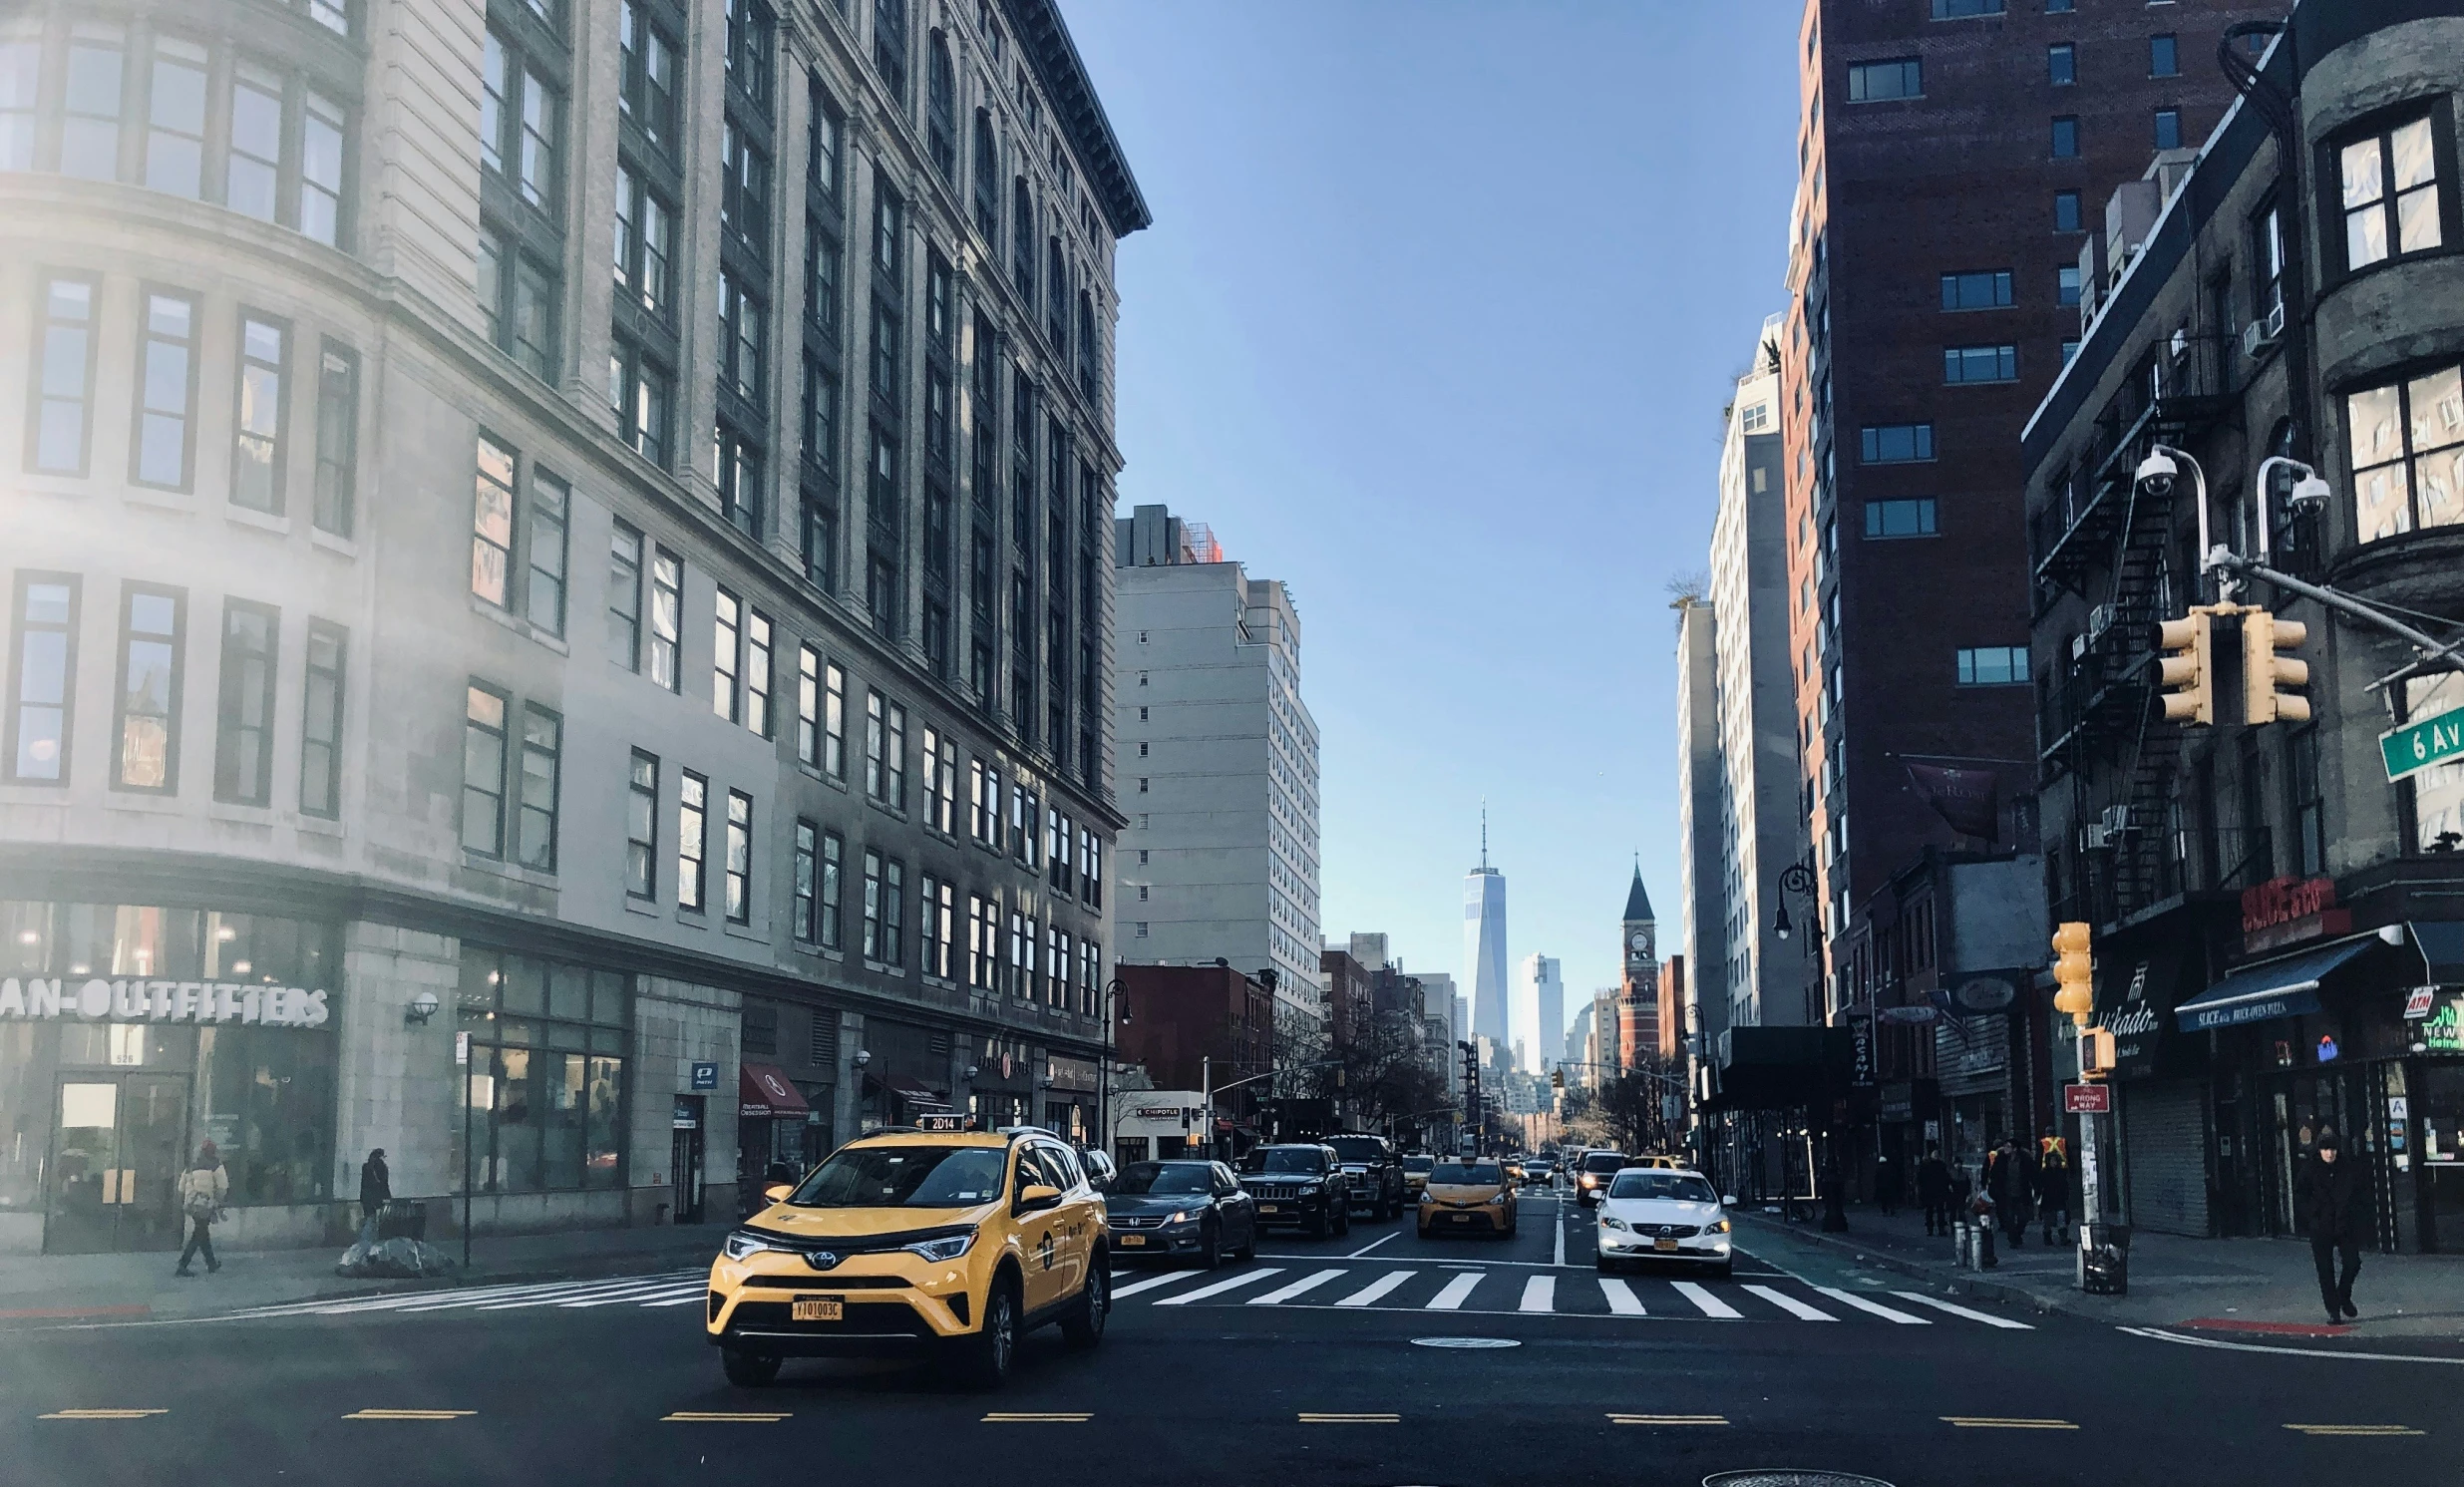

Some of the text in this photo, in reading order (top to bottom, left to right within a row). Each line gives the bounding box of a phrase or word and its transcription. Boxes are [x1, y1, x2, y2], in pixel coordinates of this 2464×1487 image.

[2414, 730, 2427, 760] 6
[2407, 994, 2431, 1010] ATM
[2198, 1010, 2220, 1027] SLICE
[2423, 1026, 2455, 1038] NEW
[117, 1055, 134, 1064] 526
[2073, 1094, 2101, 1103] WRONG
[2392, 1100, 2404, 1113] A
[932, 1117, 955, 1130] 2D14
